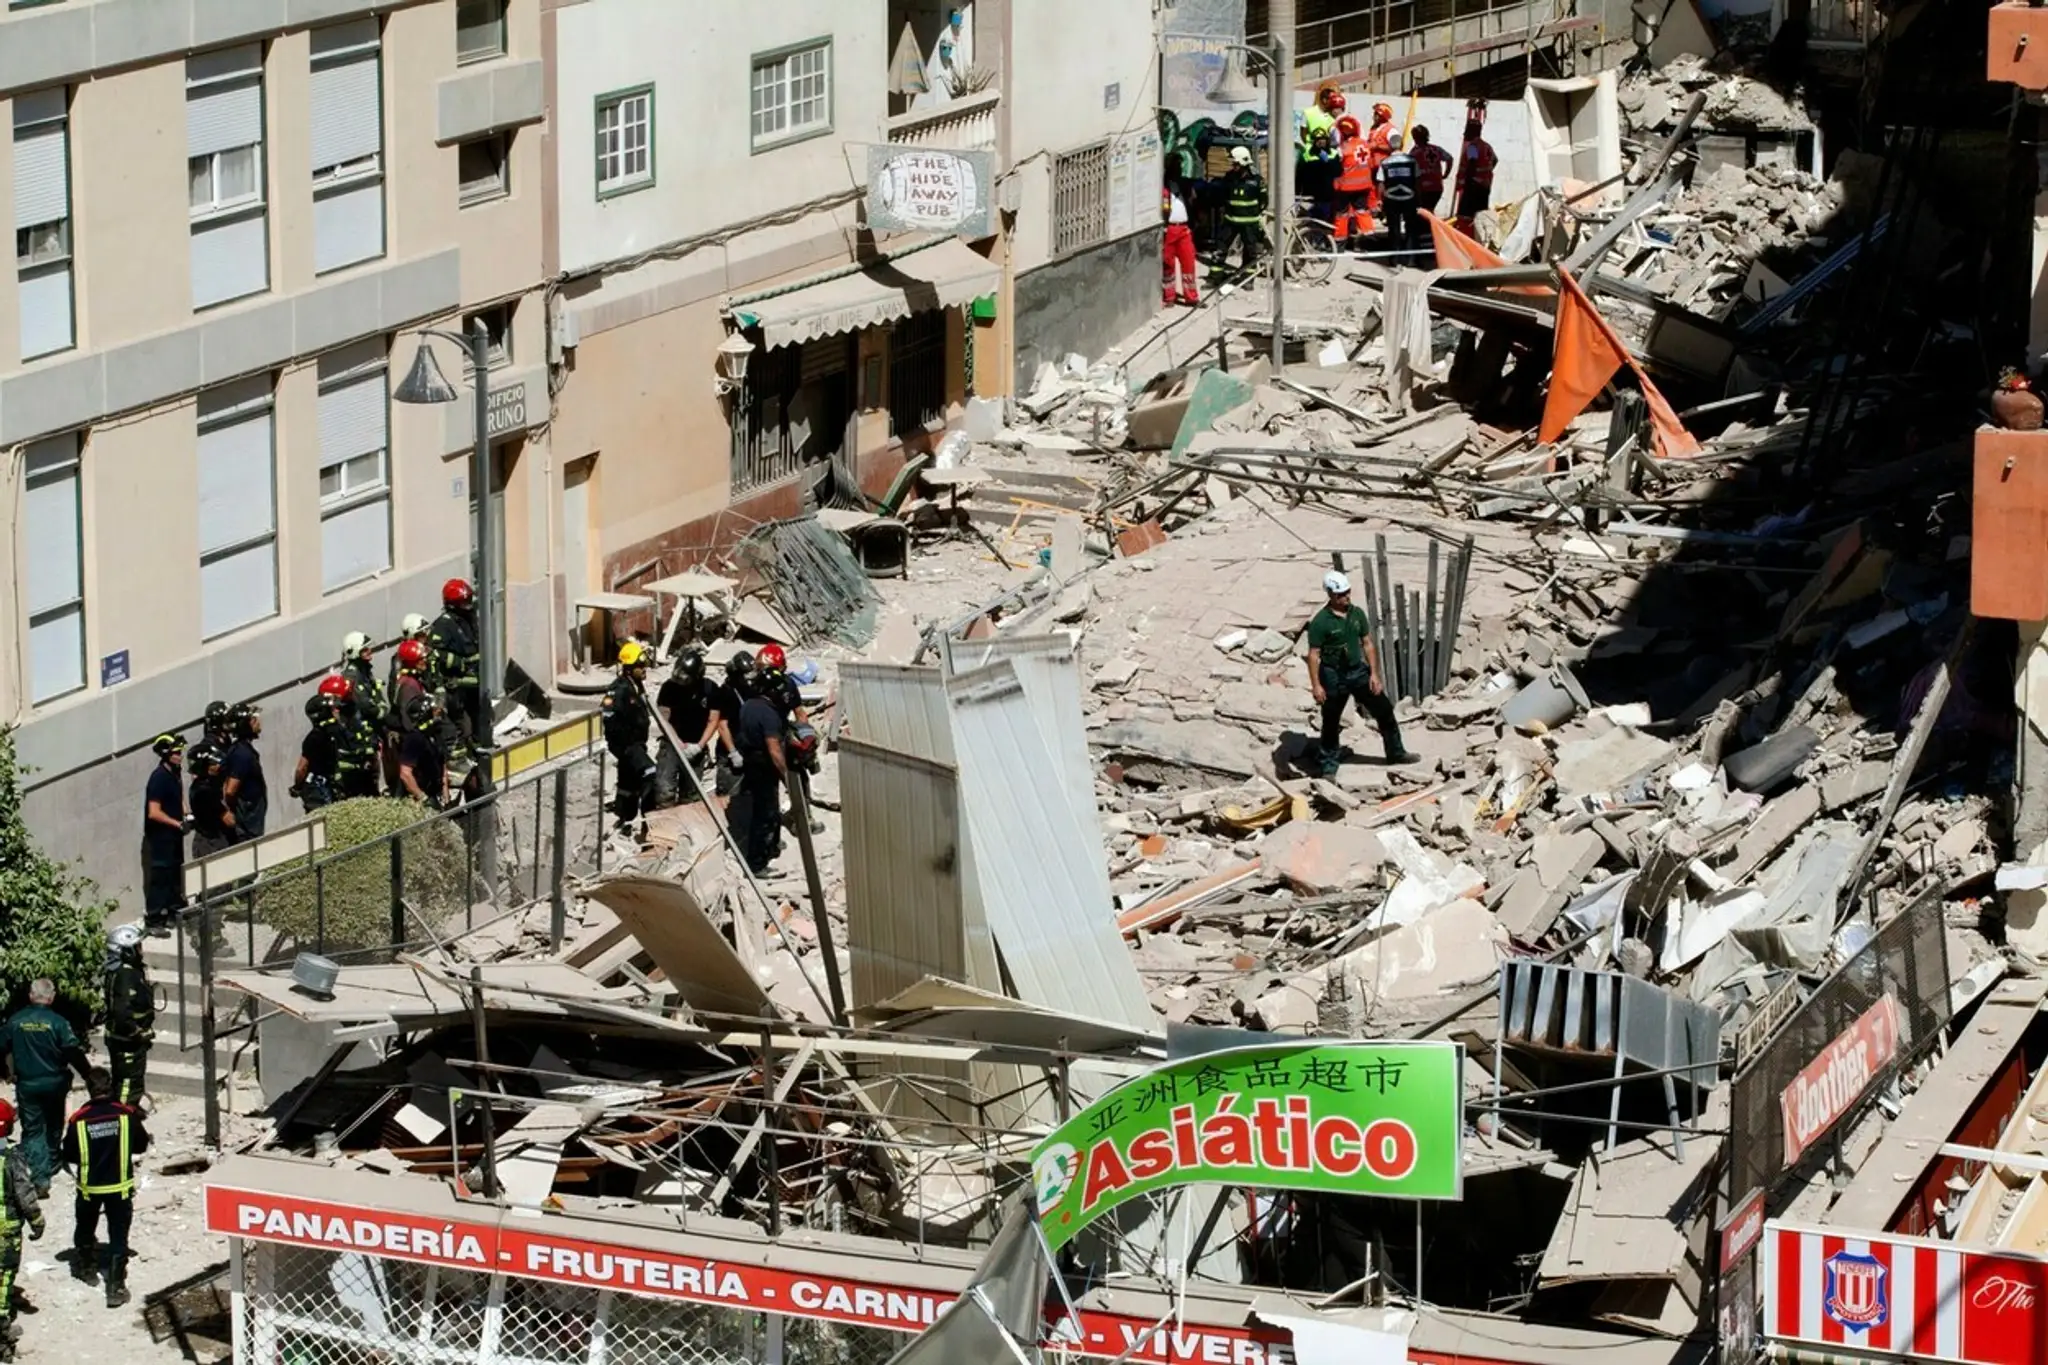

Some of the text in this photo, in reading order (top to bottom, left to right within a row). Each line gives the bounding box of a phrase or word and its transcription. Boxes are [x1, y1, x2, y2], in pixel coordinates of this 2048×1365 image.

[908, 158, 948, 170] THE
[911, 172, 953, 186] HIDE
[911, 188, 957, 201] AWAY
[917, 204, 950, 217] PUB
[488, 404, 524, 432] RUNO
[1086, 1056, 1410, 1142] 亚洲食品超市
[1081, 1093, 1416, 1215] Asiático
[238, 1205, 486, 1263] PANADERÍA
[527, 1243, 749, 1300] FRUTERÍA
[1119, 1323, 1294, 1365] VIVERE
